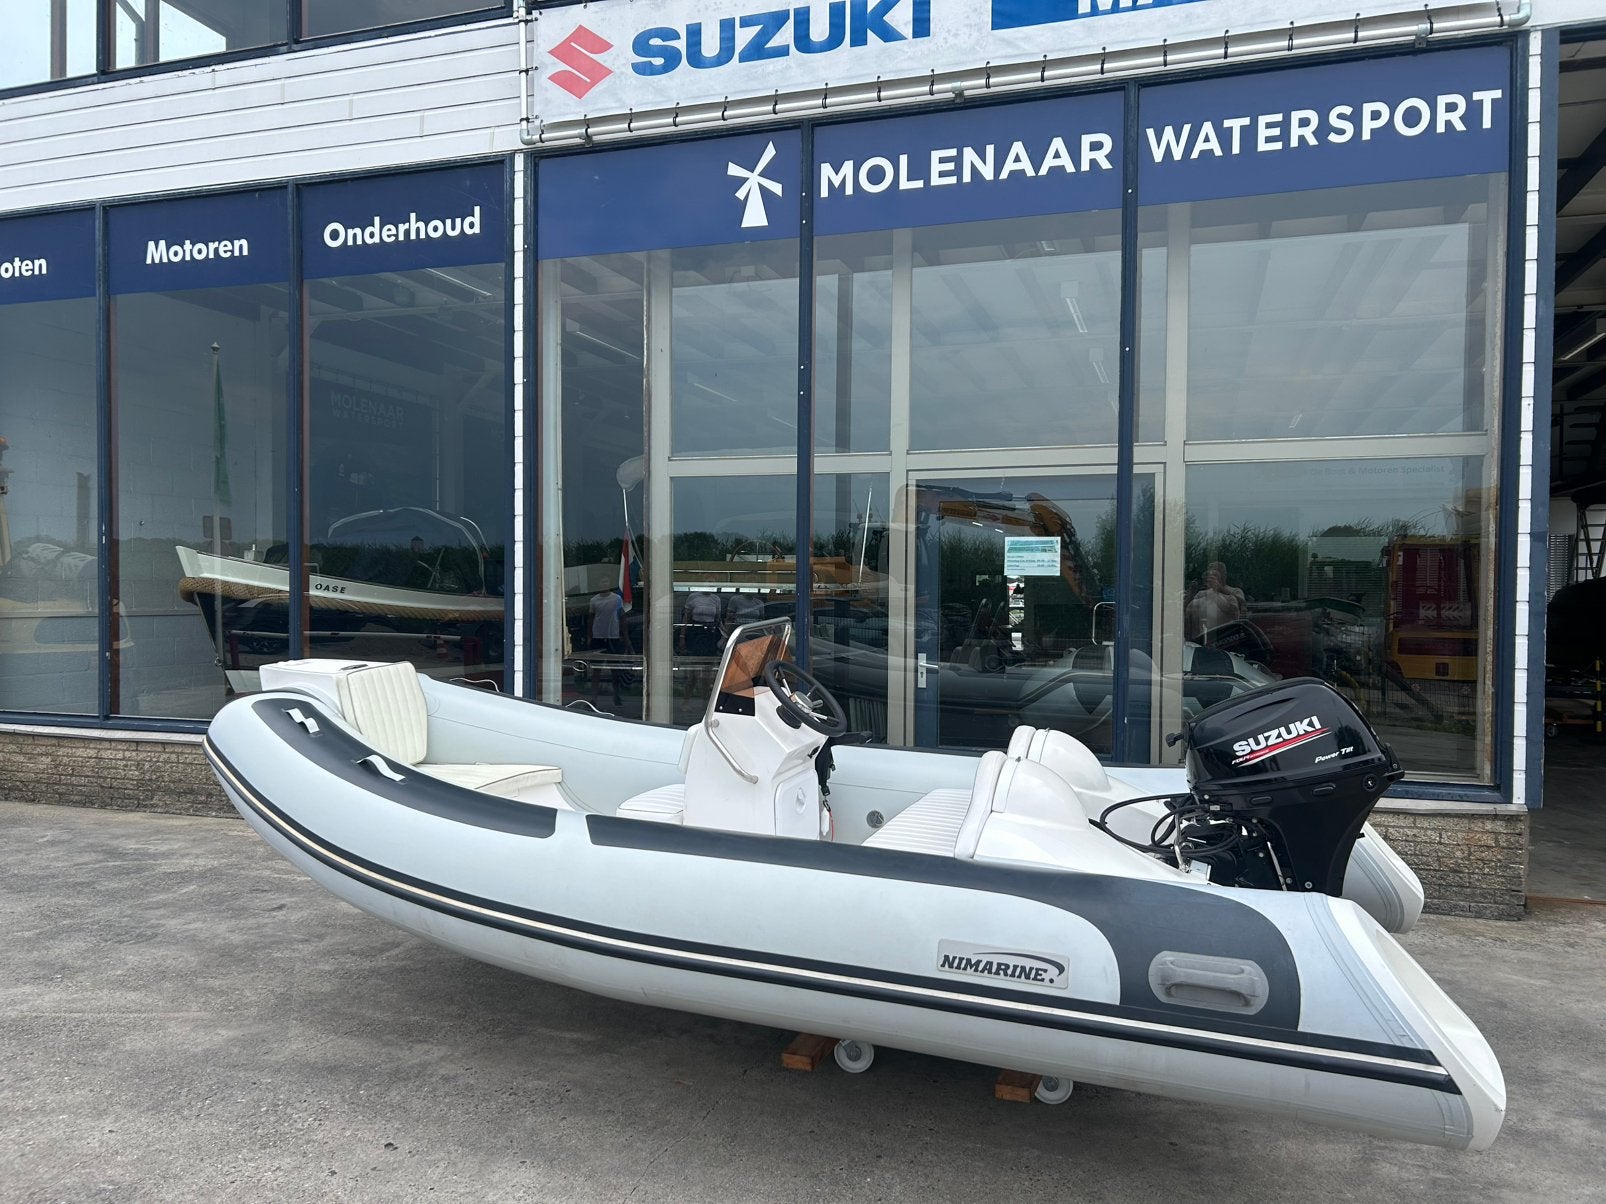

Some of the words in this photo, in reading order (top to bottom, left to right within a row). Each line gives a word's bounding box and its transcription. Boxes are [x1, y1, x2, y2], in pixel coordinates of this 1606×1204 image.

[631, 0, 932, 77] SUZUKI
[820, 132, 1113, 198] MOLENAAR
[1145, 88, 1503, 163] WATERSPORT
[323, 205, 482, 248] Onderhoud
[0, 256, 48, 279] oten
[145, 238, 249, 265] Motoren
[315, 583, 346, 594] OASE
[1233, 715, 1322, 757] SUZUKI
[1314, 750, 1340, 764] Power
